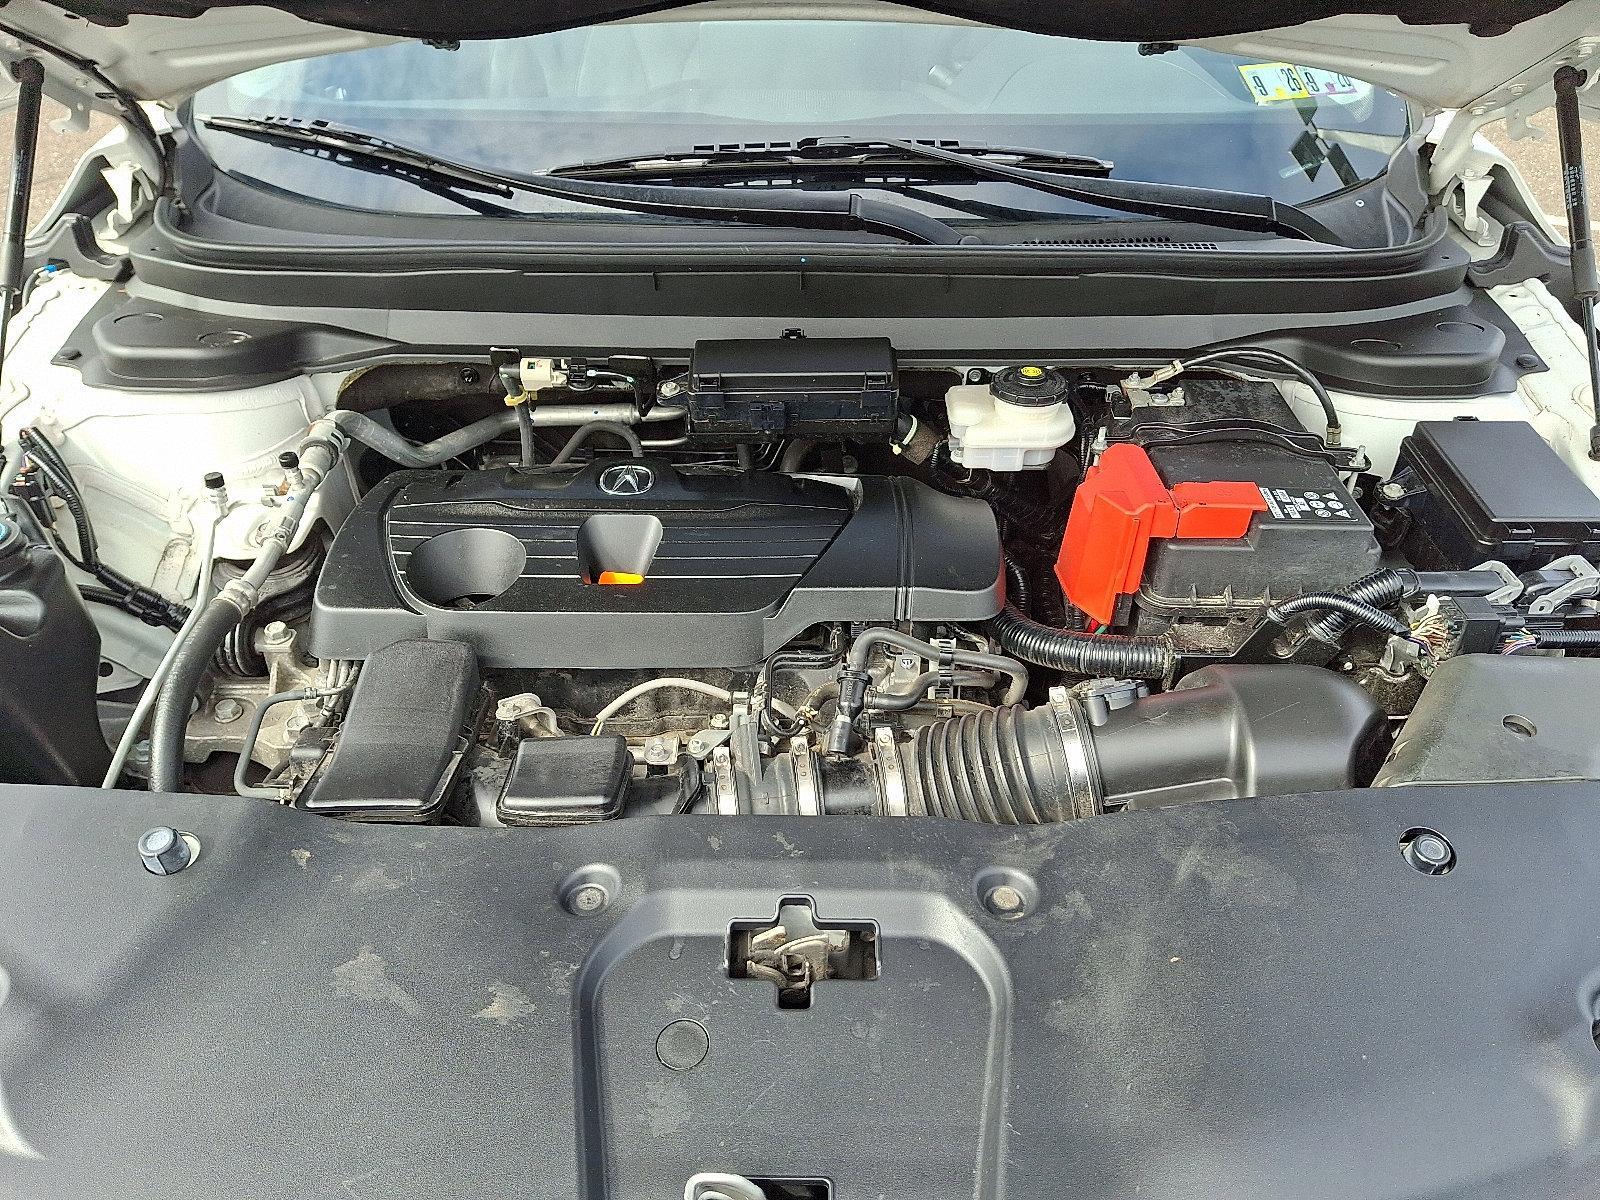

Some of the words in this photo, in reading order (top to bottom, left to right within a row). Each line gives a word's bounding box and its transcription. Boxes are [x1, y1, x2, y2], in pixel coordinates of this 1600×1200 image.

[1252, 75, 1268, 96] 9
[1280, 68, 1302, 91] 26
[1304, 72, 1320, 92] 9
